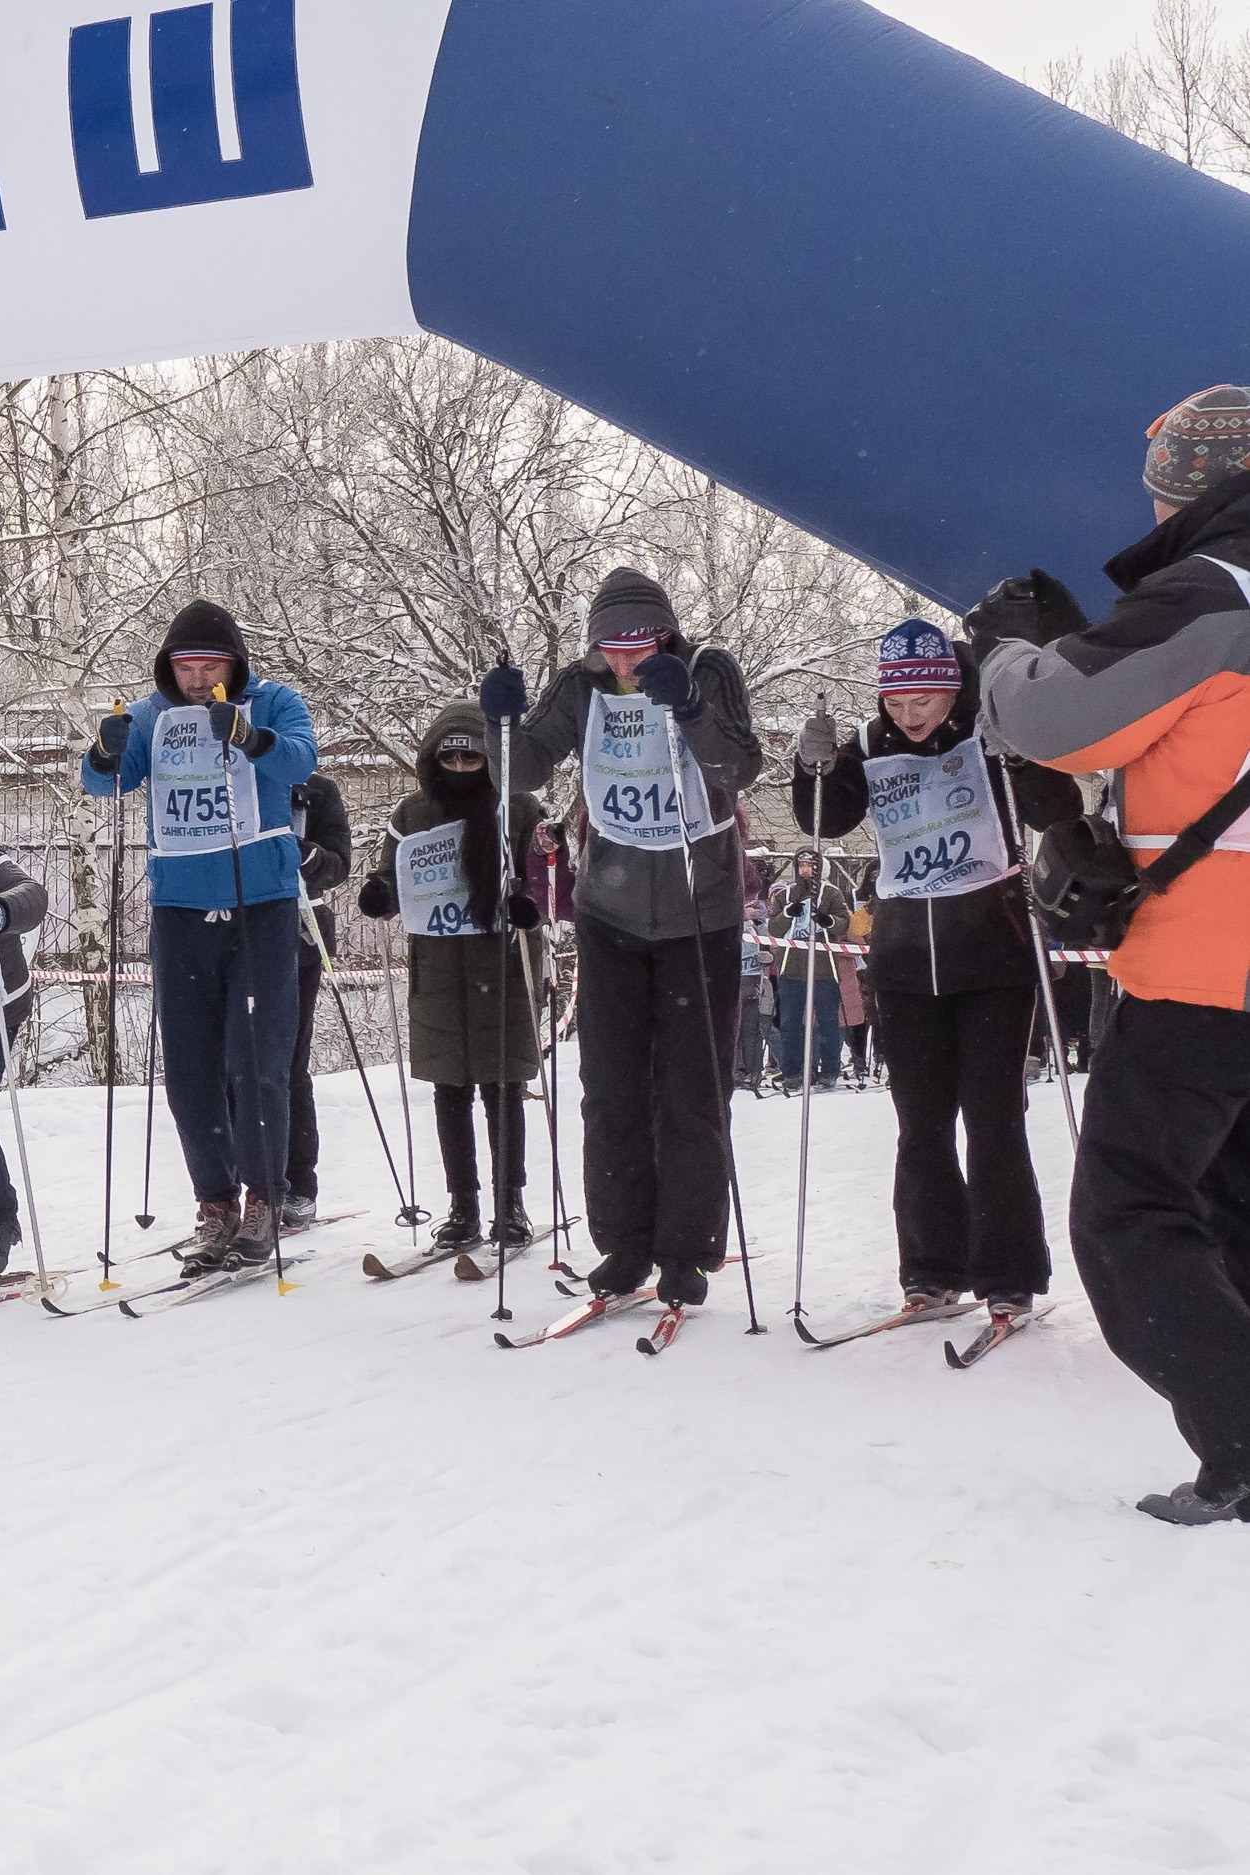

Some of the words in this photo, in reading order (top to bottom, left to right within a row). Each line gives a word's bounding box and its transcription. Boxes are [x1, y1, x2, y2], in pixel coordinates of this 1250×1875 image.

[166, 785, 230, 822] 4755
[602, 783, 680, 823] 4314
[876, 799, 920, 829] 2021
[410, 837, 456, 860] ЛЫЖНЯ
[410, 850, 457, 870] РОССИИ
[894, 830, 971, 884] 4342
